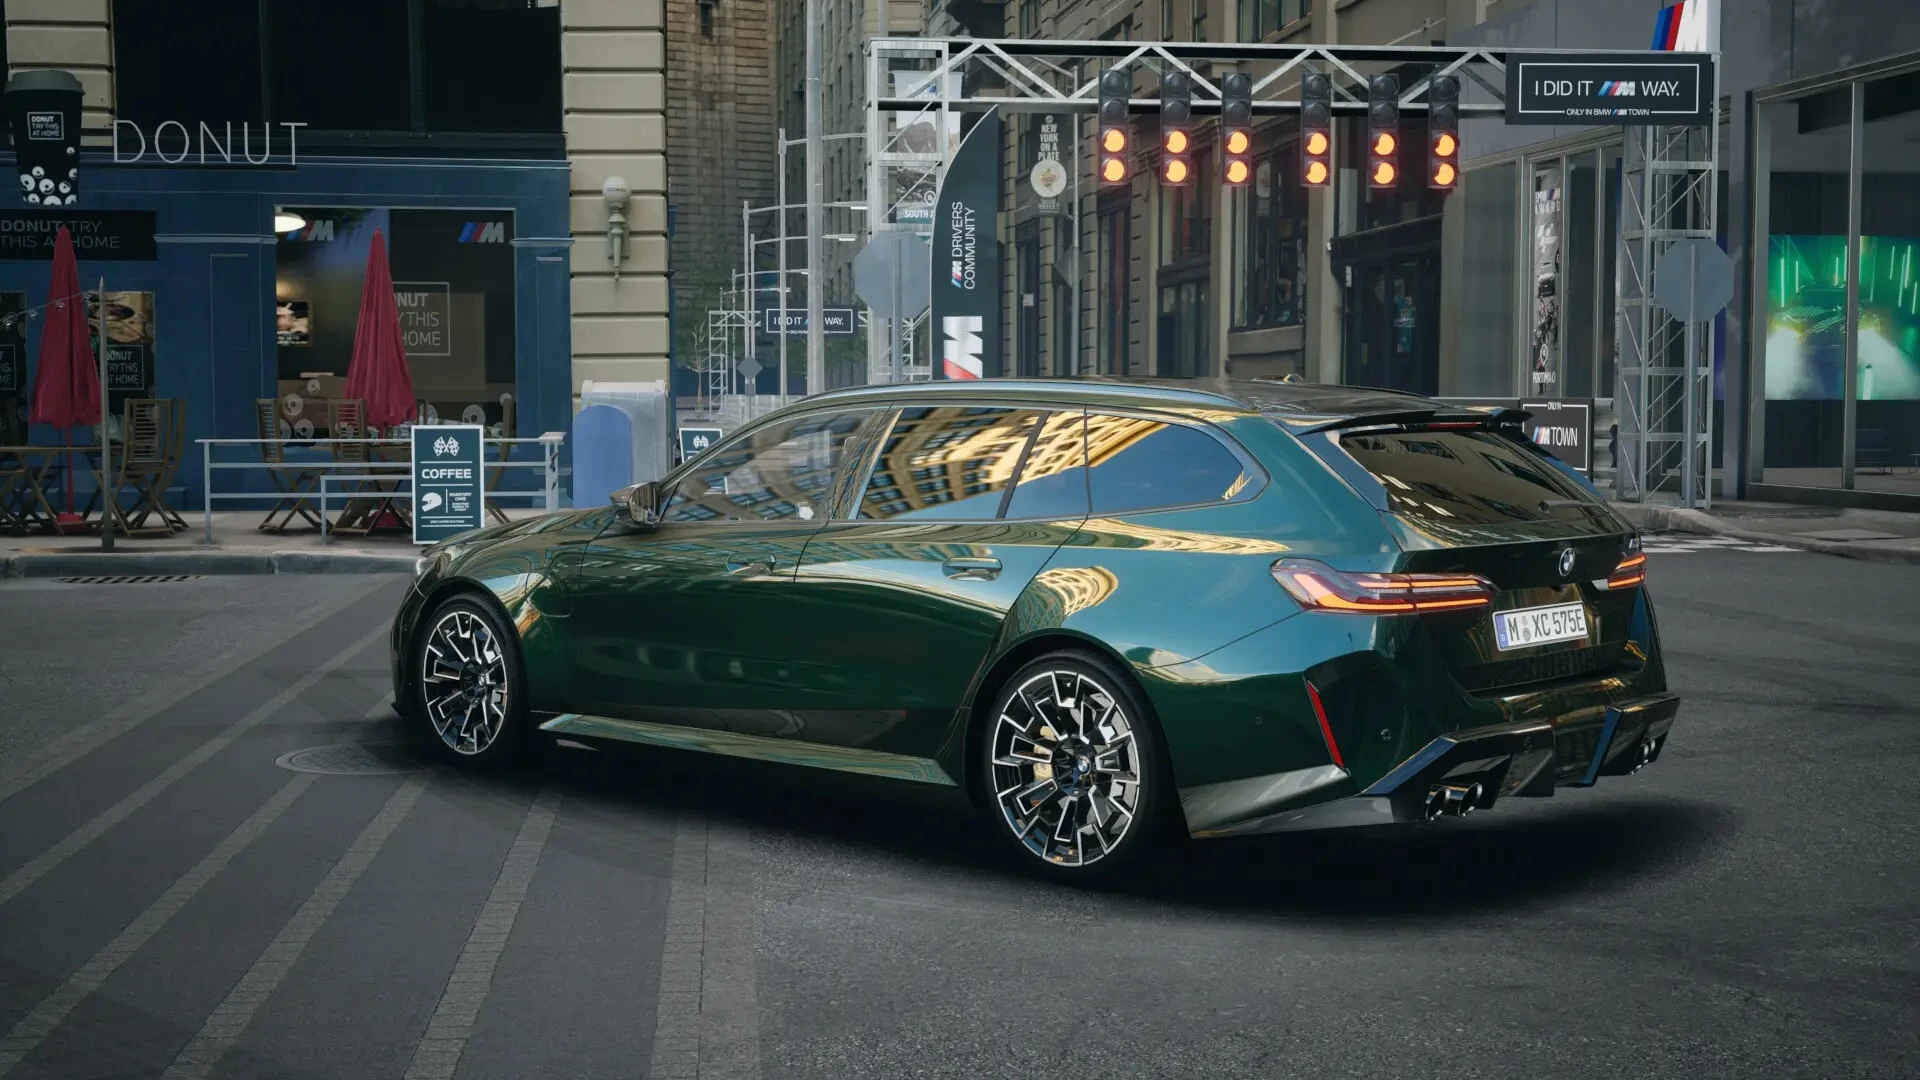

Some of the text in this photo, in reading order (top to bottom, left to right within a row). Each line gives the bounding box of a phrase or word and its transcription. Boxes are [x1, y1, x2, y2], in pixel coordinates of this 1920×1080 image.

[1535, 81, 1539, 96] I
[1544, 81, 1573, 96] DID
[1578, 81, 1594, 96] IT
[1641, 81, 1680, 97] WAY.
[1566, 108, 1584, 116] ONLY
[1585, 108, 1593, 116] IN
[1593, 108, 1612, 116] BMW
[1628, 108, 1650, 116] TOWN
[31, 115, 55, 123] DONUT
[1041, 123, 1058, 133] NEW
[113, 119, 308, 165] DONUT
[1039, 133, 1059, 143] YORK
[1040, 143, 1058, 152] ON A
[1037, 151, 1060, 161] PLATE
[903, 209, 929, 219] SOUTH
[0, 219, 102, 233] DONUT TRY
[952, 201, 963, 258] DRIVERS
[0, 235, 37, 248] THIS
[963, 207, 976, 290] COMMUNITY
[394, 292, 429, 307] NUT
[405, 311, 440, 327] THIS
[824, 316, 844, 326] WAY.
[1547, 401, 1558, 410] ONLY
[1550, 426, 1578, 446] TOWN
[421, 468, 472, 479] COFFEE
[1507, 608, 1586, 642] M XC 575E
